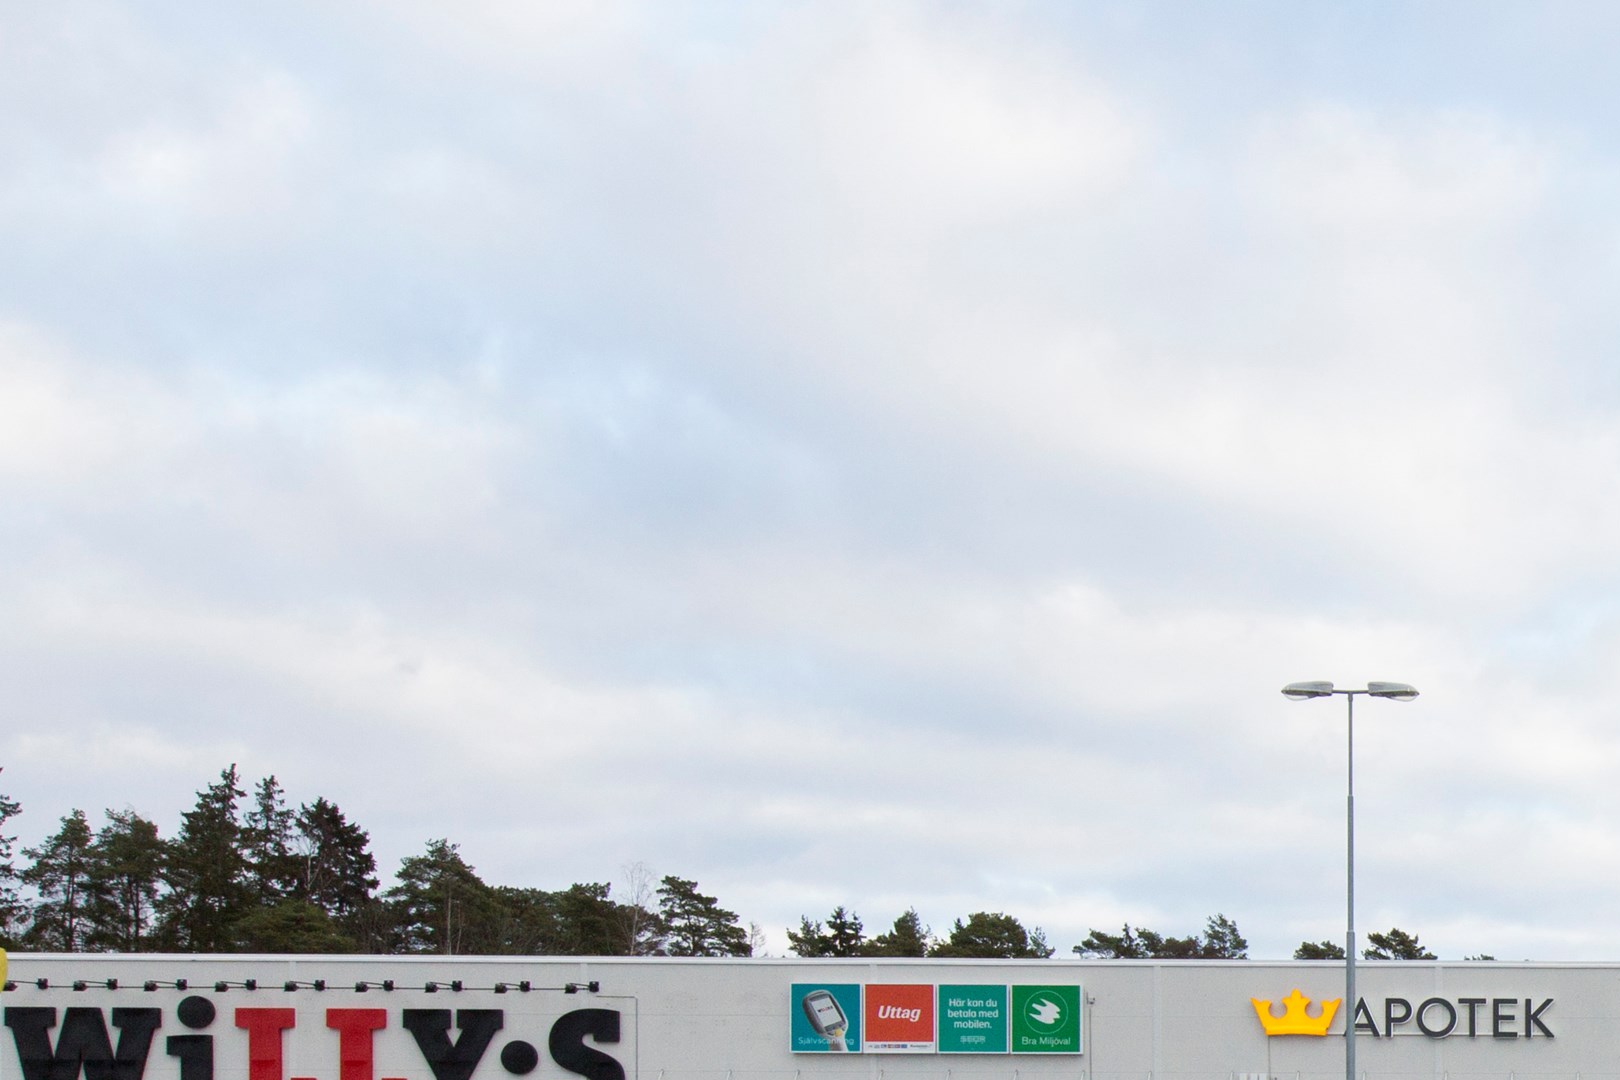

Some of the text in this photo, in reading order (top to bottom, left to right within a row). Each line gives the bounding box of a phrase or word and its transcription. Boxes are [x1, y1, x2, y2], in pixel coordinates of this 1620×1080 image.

[949, 998, 998, 1007] Här kan du
[878, 1005, 921, 1022] Uttag
[947, 1009, 999, 1018] betala med
[1343, 997, 1555, 1039] APOTEK
[953, 1020, 992, 1029] mobilen.
[1022, 1036, 1071, 1047] Bra Miljöval
